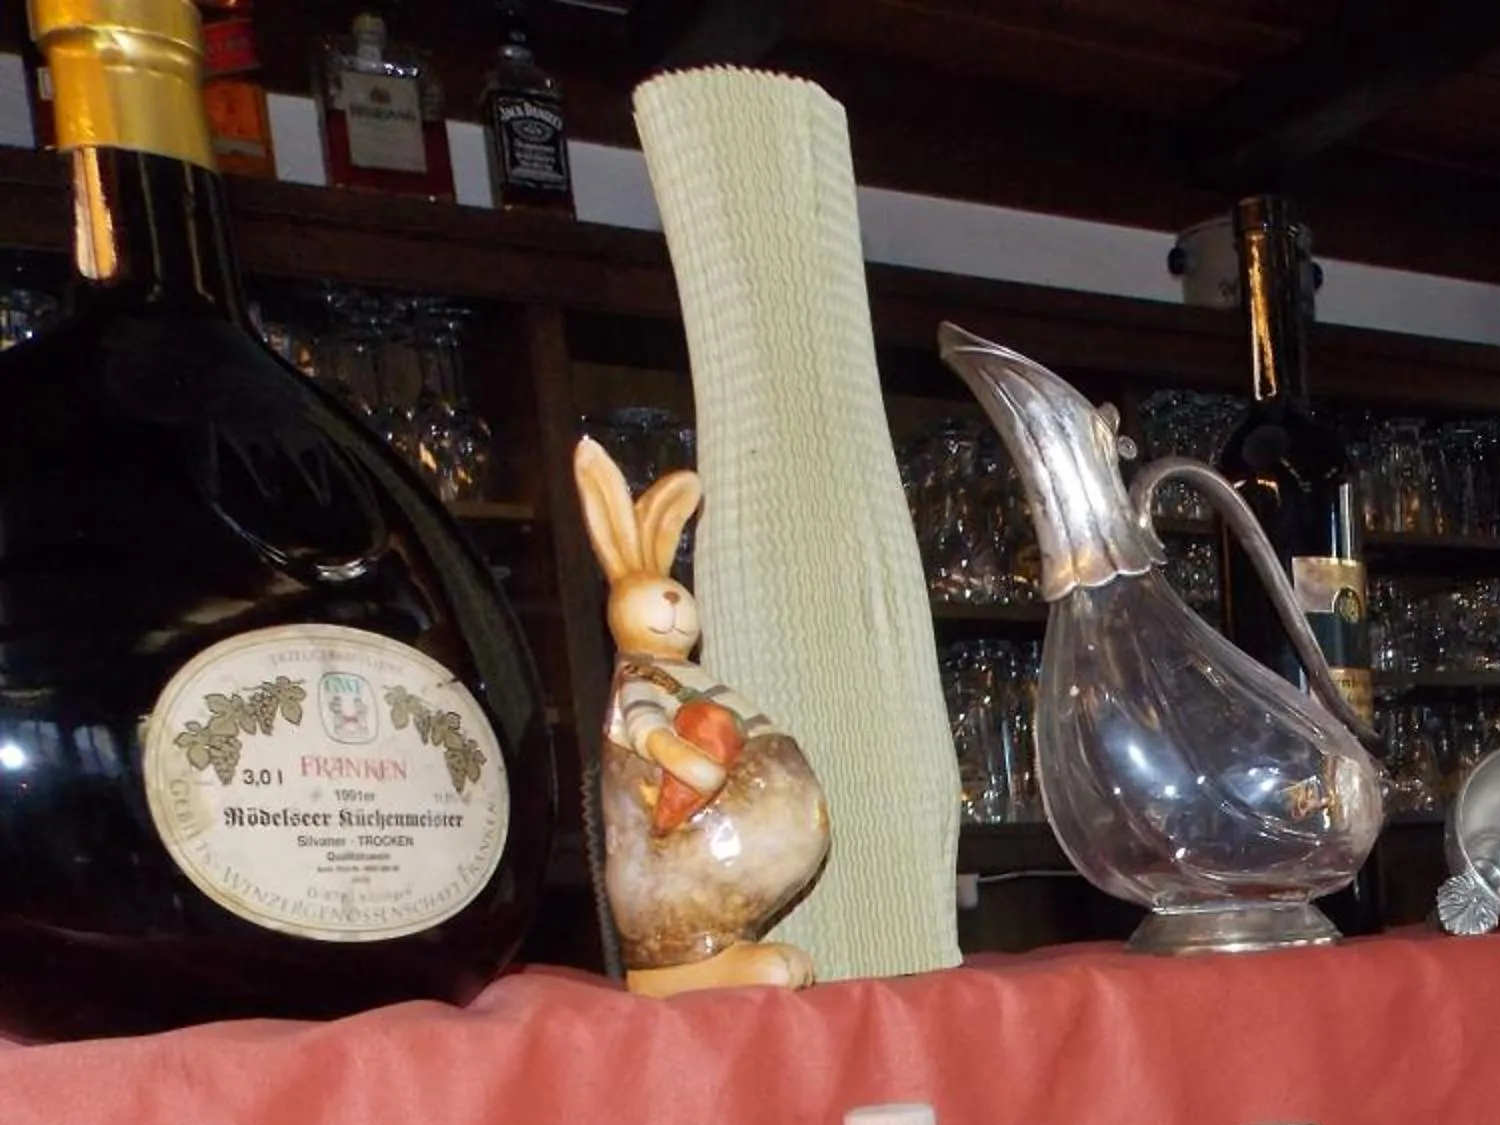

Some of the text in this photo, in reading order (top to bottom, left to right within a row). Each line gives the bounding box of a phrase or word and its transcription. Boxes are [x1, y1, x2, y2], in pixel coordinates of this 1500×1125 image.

[243, 768, 271, 787] 3,0
[301, 756, 408, 780] FRANKEN
[359, 836, 415, 848] TROCKEN
